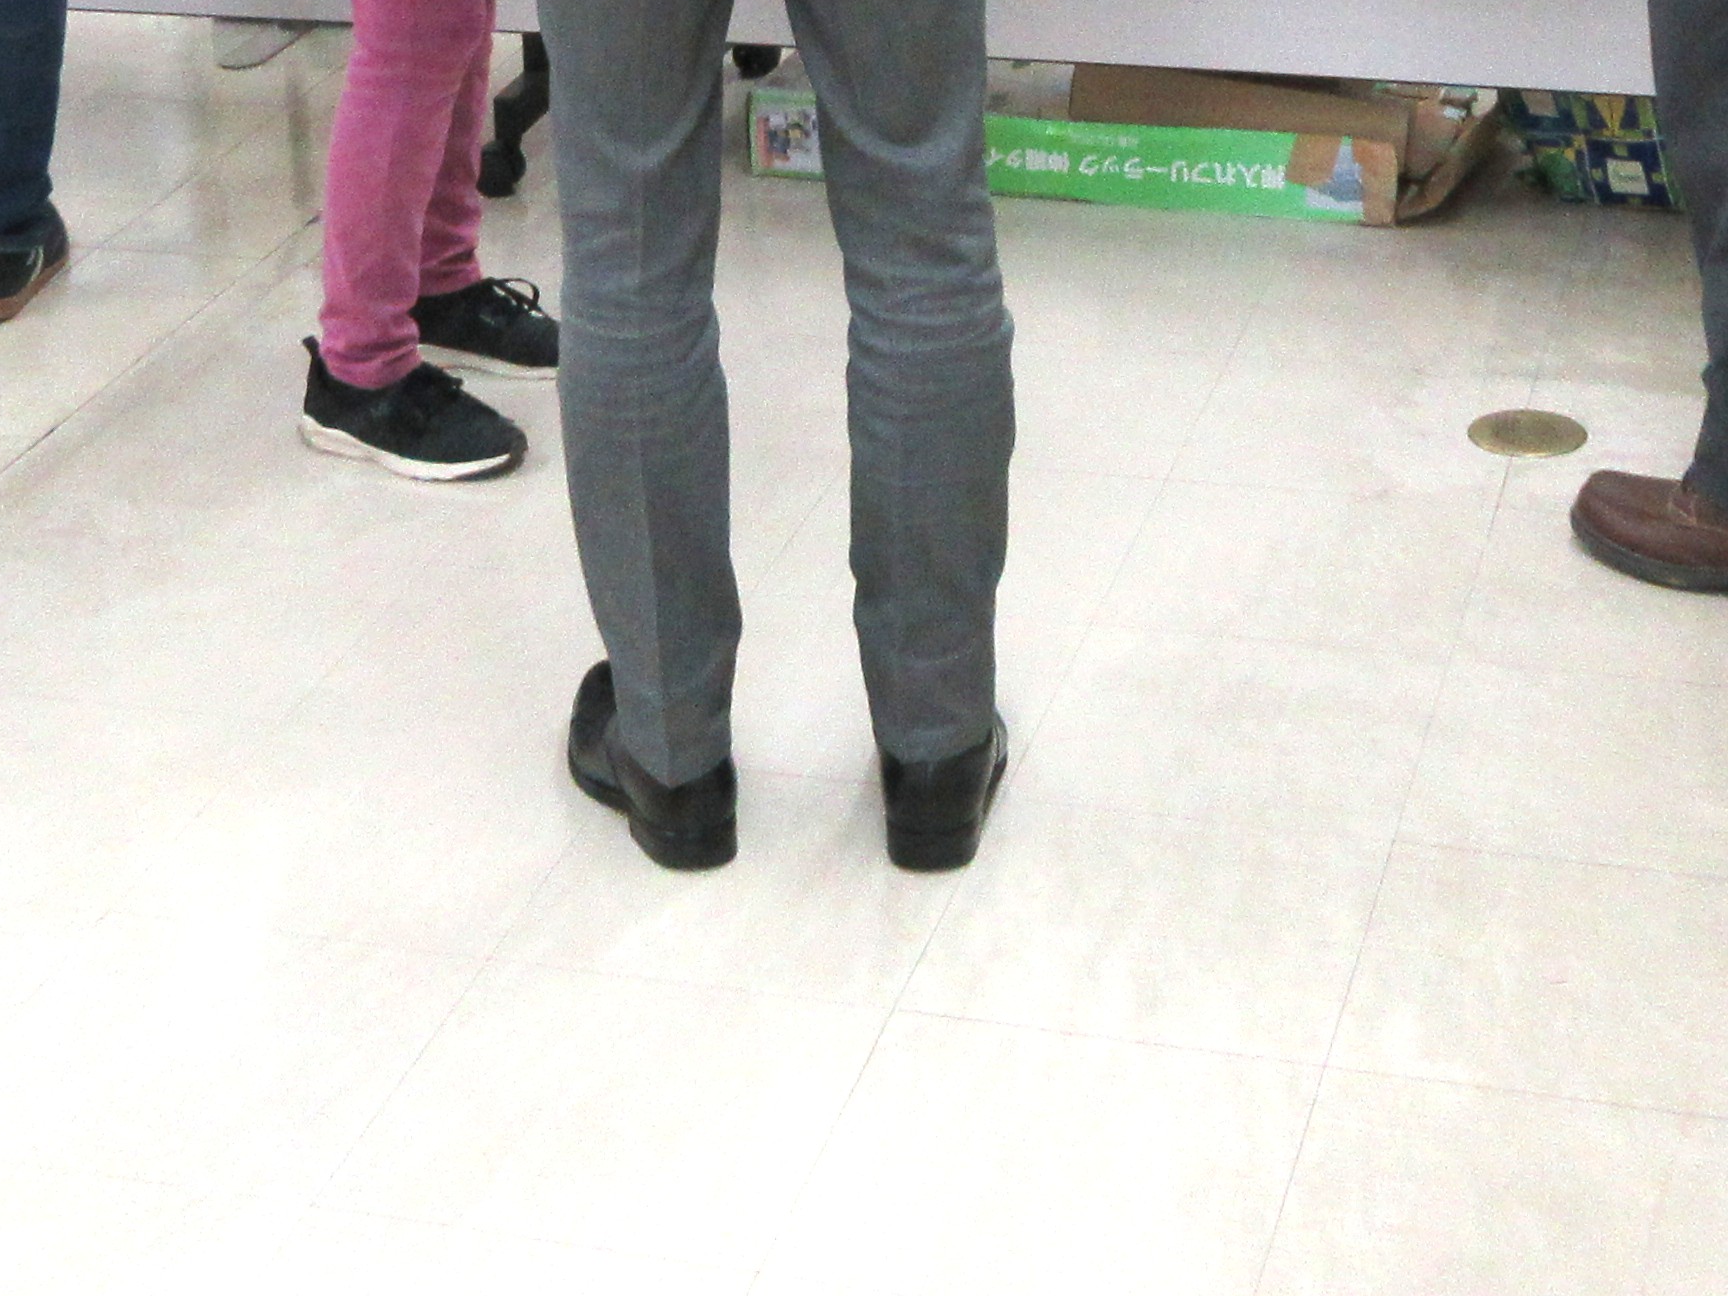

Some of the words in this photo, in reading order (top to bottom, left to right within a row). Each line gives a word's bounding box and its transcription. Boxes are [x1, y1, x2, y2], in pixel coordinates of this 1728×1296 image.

[1078, 153, 1286, 190] 押入れフリーラック
